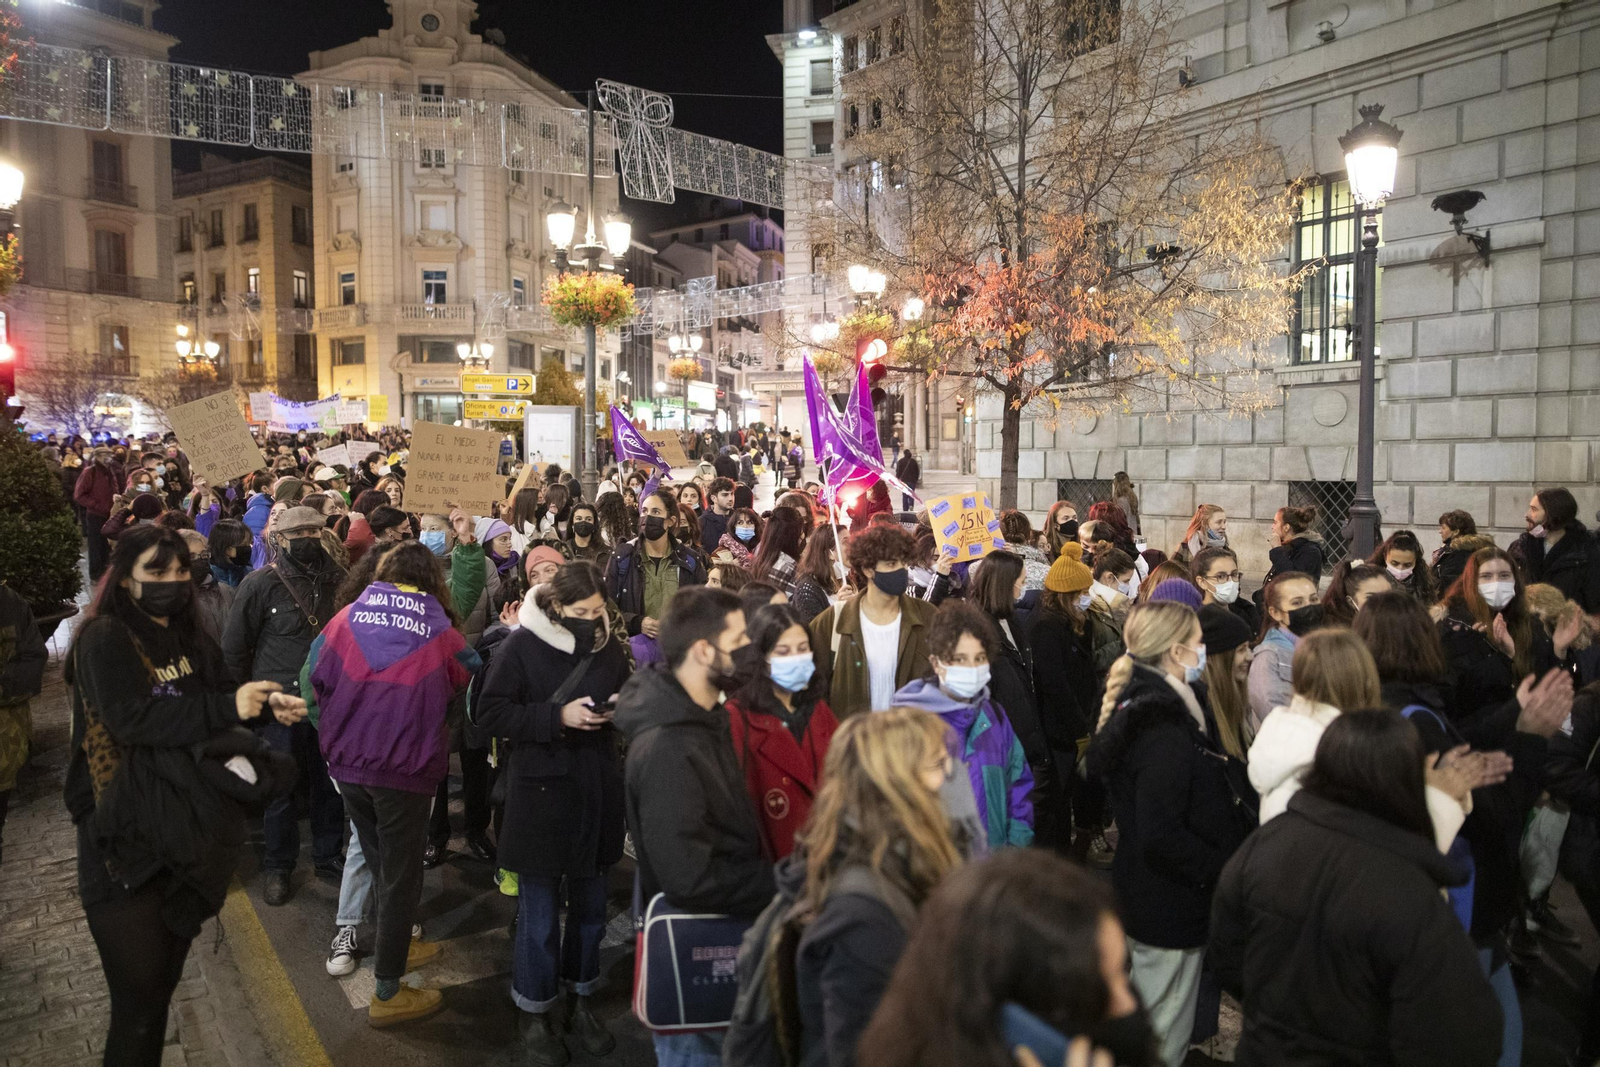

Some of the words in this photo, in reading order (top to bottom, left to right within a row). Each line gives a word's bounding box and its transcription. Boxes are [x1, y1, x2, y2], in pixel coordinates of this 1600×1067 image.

[174, 406, 196, 421] HOY
[205, 399, 219, 411] NO
[209, 408, 239, 424] TODAS
[200, 422, 237, 443] NUESTRAS
[436, 434, 444, 445] EL
[189, 444, 211, 458] VOCES
[212, 435, 238, 450] JUNTAS
[222, 442, 247, 457] TUMBA
[417, 452, 440, 462] NUNCA
[445, 454, 453, 464] VA
[457, 455, 462, 463] A
[465, 456, 480, 464] SER
[214, 459, 251, 481] GRITAR
[417, 470, 444, 482] GRANDE
[473, 473, 491, 482] AMOR
[428, 486, 439, 494] LAS
[442, 487, 459, 495] TUYAS
[366, 593, 388, 606] PARA
[390, 594, 426, 615] TODAS
[353, 611, 389, 627] TODES,
